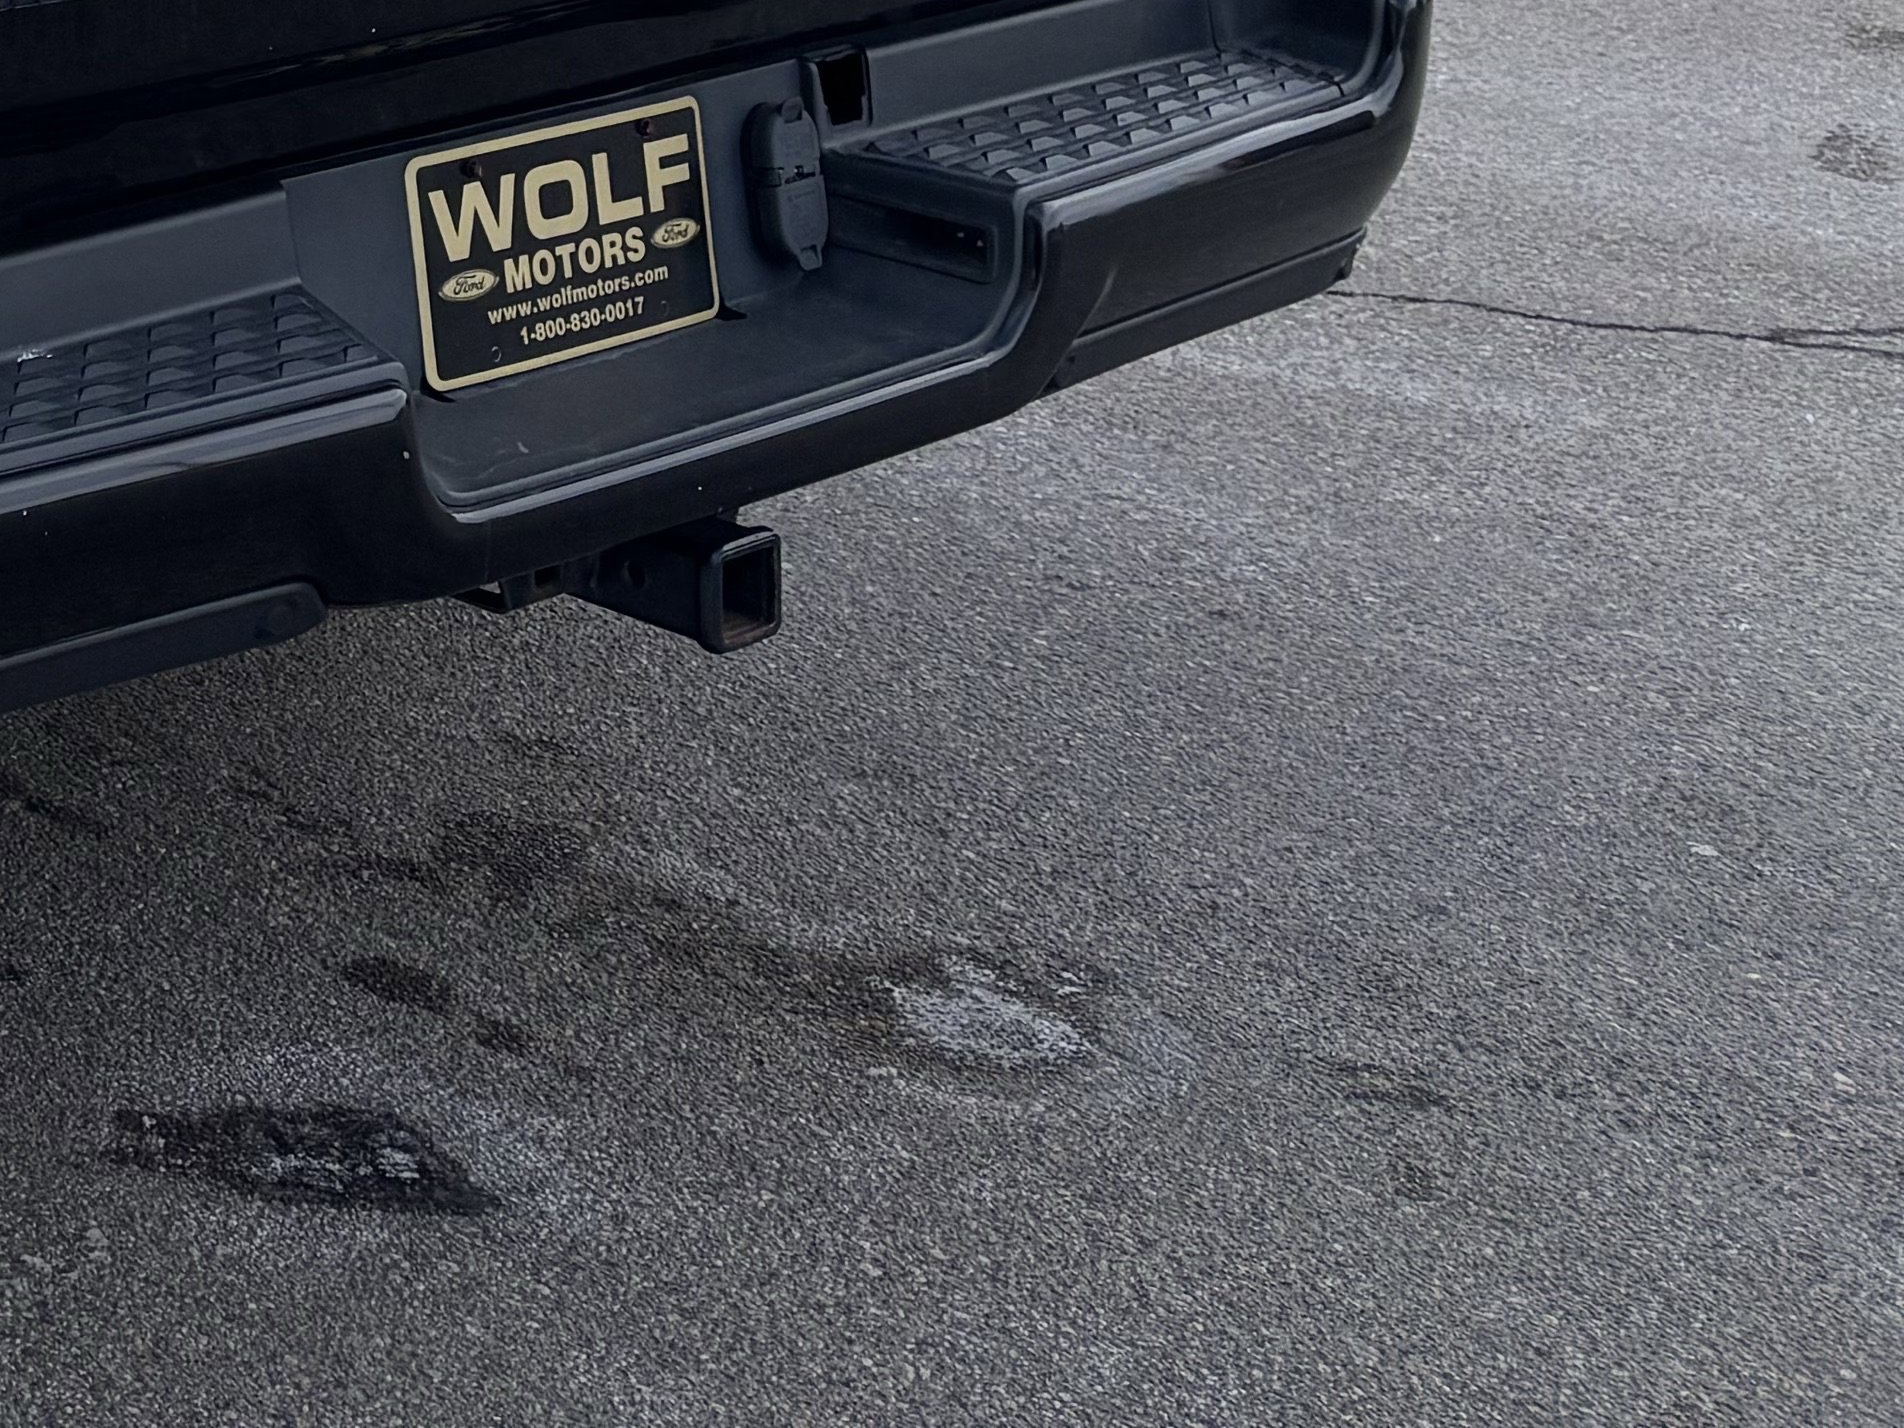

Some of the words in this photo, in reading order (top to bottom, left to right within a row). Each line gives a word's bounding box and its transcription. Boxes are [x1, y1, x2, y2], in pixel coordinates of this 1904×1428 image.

[427, 133, 691, 263] WOLF
[503, 226, 646, 294] MOTORS
[659, 220, 690, 245] Ford
[452, 273, 487, 295] Ford
[488, 264, 669, 325] www.wolfmotors.com
[520, 296, 645, 346] 1-800-830-0017
